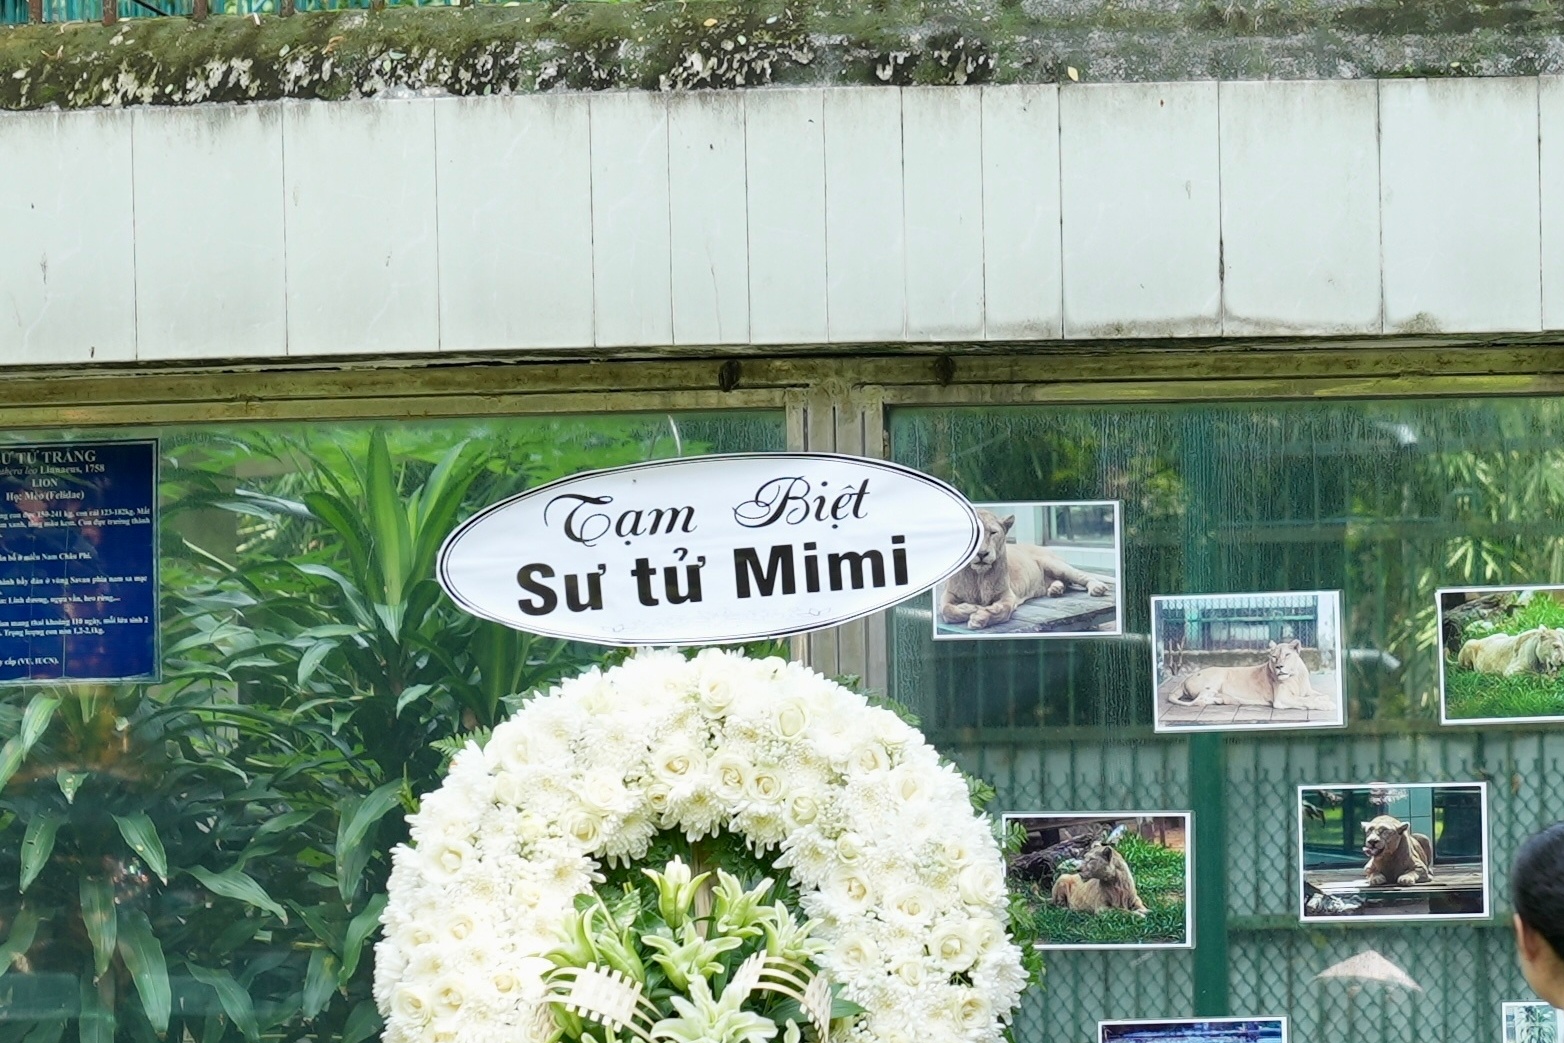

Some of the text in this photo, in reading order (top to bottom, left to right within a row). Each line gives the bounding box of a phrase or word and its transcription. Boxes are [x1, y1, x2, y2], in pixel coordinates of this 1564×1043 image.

[85, 464, 105, 473] 1758
[32, 478, 58, 488] LION
[46, 490, 85, 501] (Felidae)
[543, 475, 871, 548] Tạm Biệt
[516, 535, 910, 616] Sư tử Mimi
